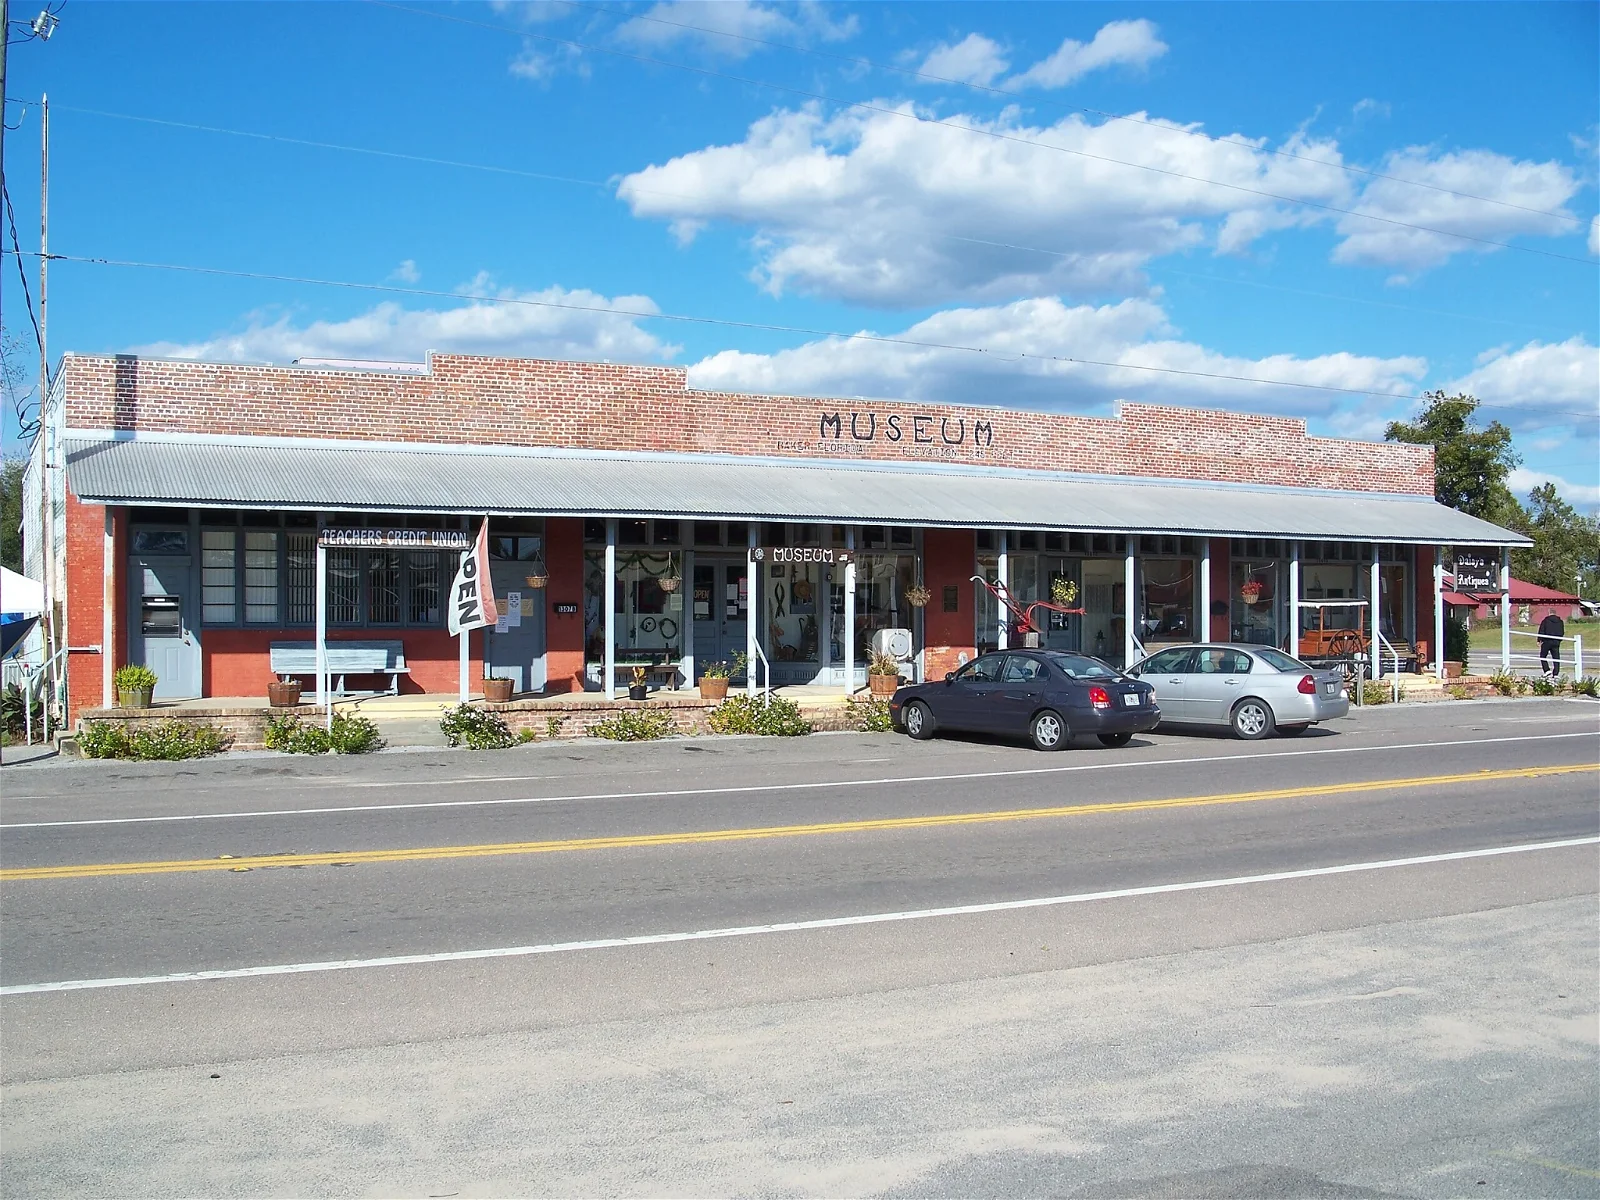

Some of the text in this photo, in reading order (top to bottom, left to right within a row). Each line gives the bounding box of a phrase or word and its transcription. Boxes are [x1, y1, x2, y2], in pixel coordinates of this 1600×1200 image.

[820, 411, 993, 447] MUSEUM
[777, 440, 863, 453] BAKER FLORIDA
[902, 446, 957, 459] ELEVATION
[322, 529, 467, 547] TEACHERS CREDIT UNION
[773, 547, 833, 563] MUSEUM
[457, 542, 481, 625] PEN
[1457, 574, 1489, 589] Antiques
[694, 590, 710, 600] OPEN
